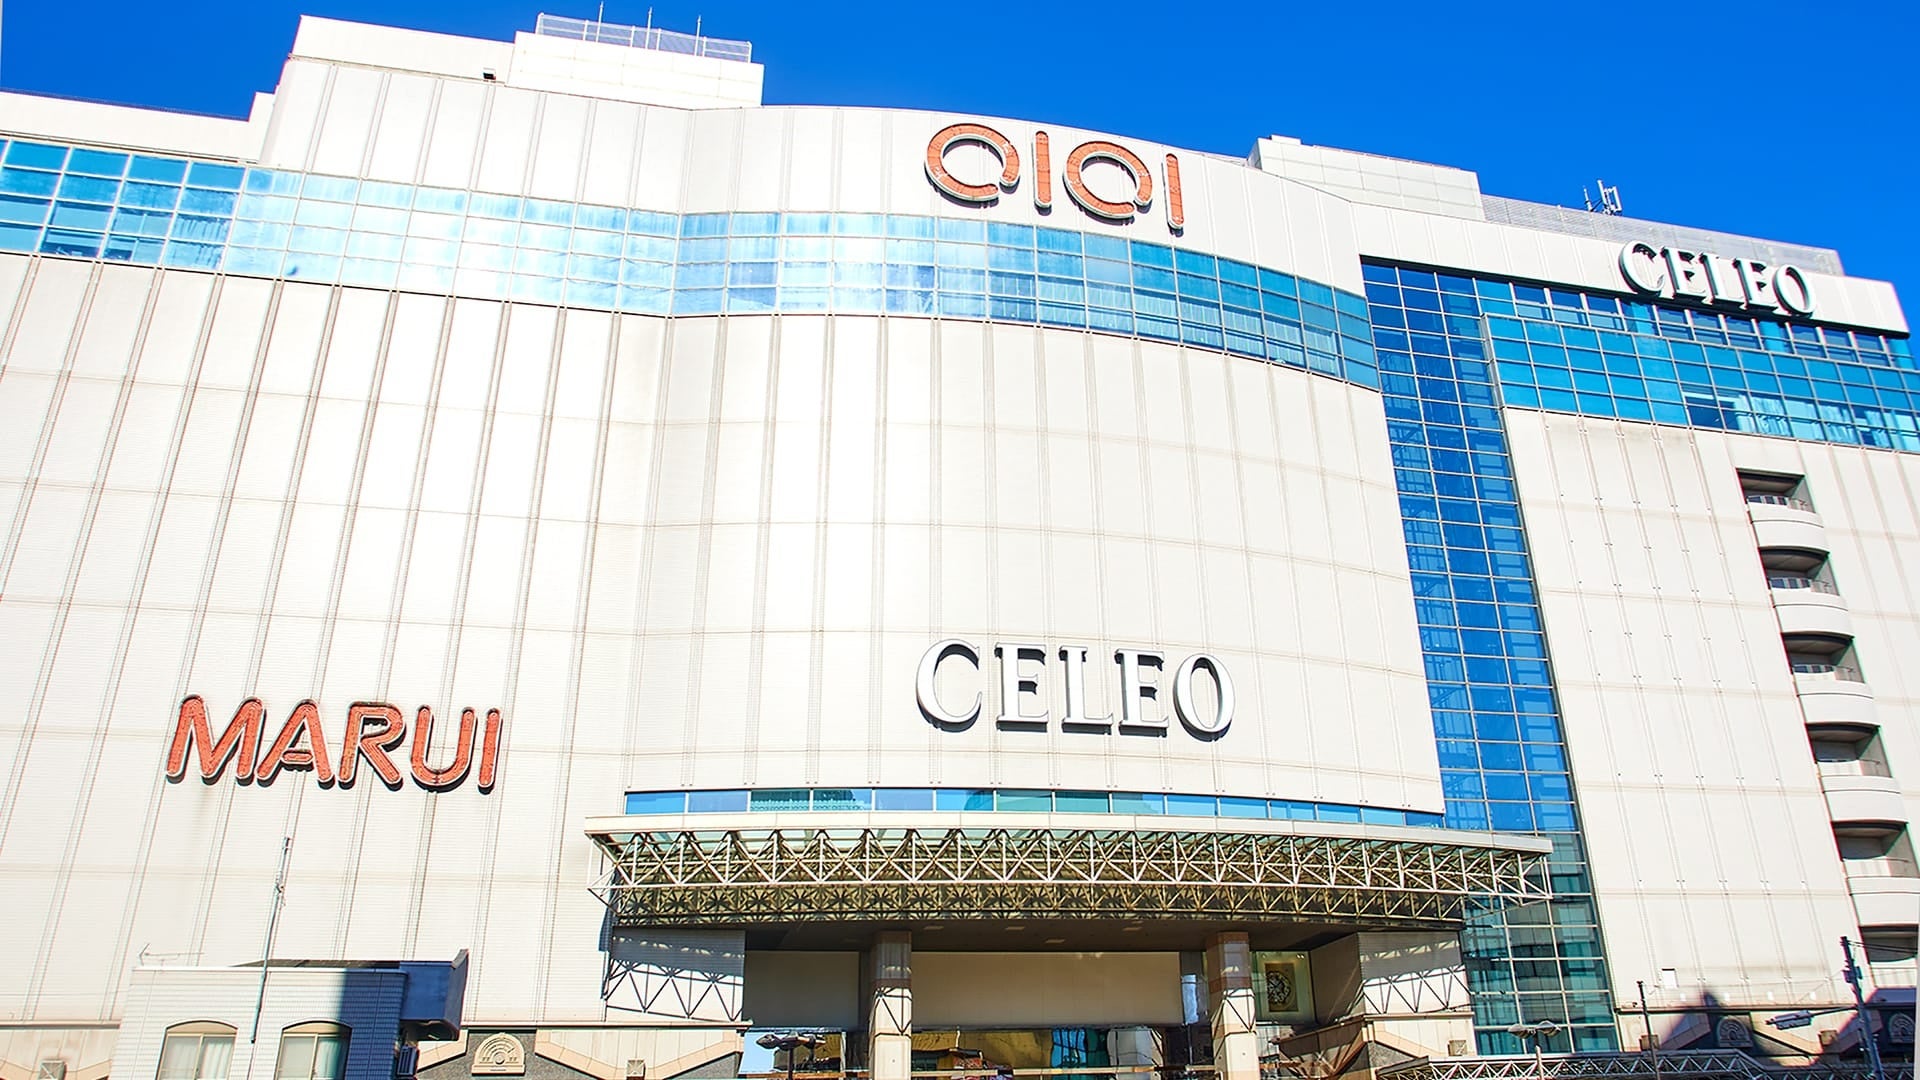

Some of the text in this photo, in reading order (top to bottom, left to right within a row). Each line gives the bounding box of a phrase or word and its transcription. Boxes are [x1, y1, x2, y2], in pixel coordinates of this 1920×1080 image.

[1619, 240, 1817, 317] CELEO
[915, 638, 1235, 741] CELEO
[166, 694, 502, 793] MARUI
